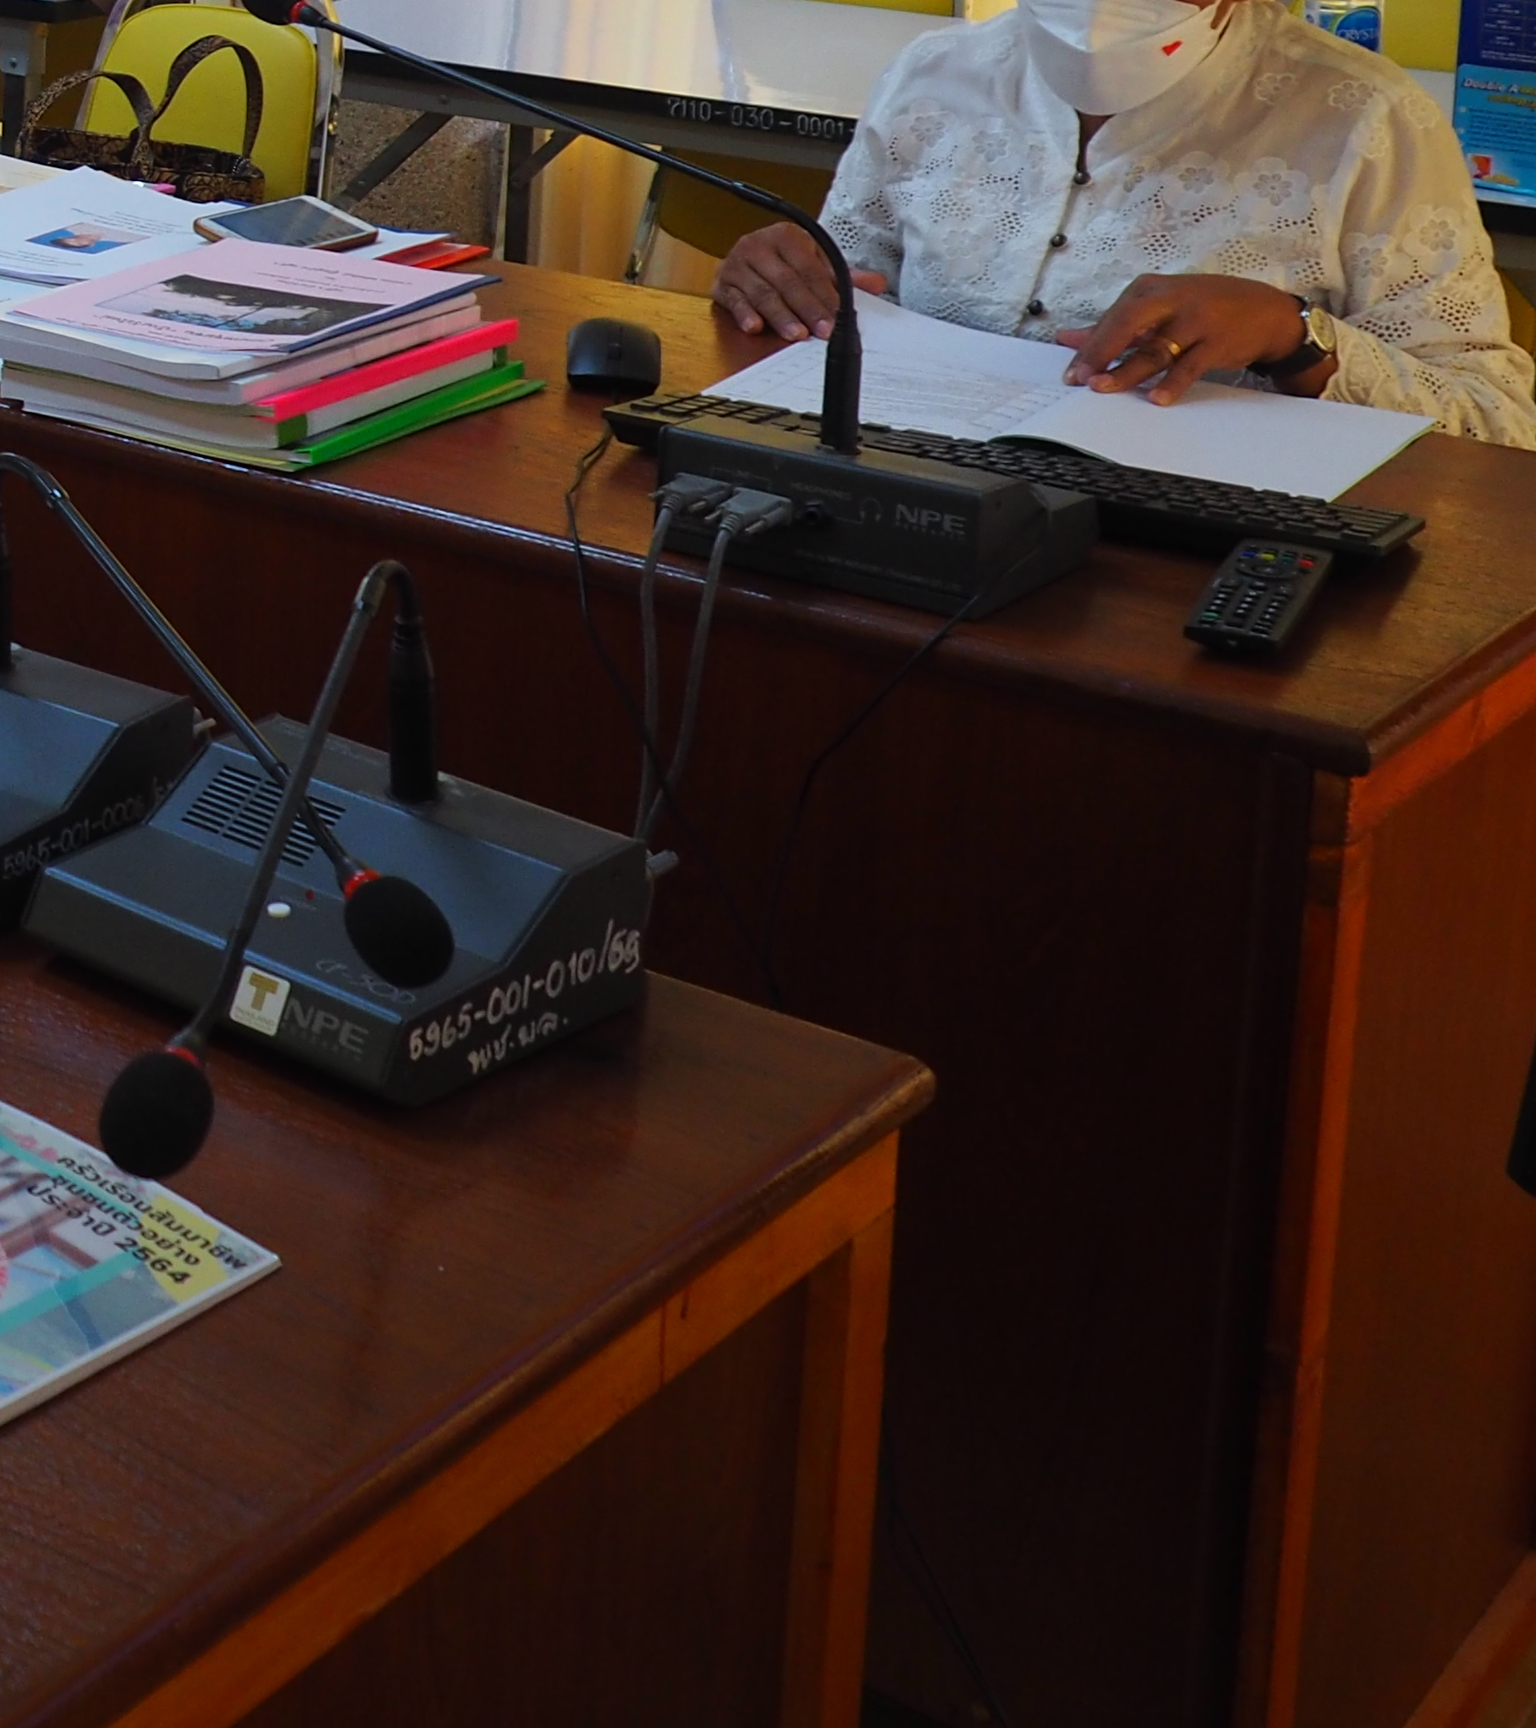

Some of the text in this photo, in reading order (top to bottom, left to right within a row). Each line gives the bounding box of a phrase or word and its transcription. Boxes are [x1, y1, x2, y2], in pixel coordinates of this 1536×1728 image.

[894, 503, 967, 533] NPE
[283, 997, 370, 1054] NPE
[50, 1174, 201, 1267] ชุมชนตัวอย่าง
[57, 1156, 248, 1270] ครัวเรือนสัมมาชีพ
[114, 1237, 192, 1285] 2564
